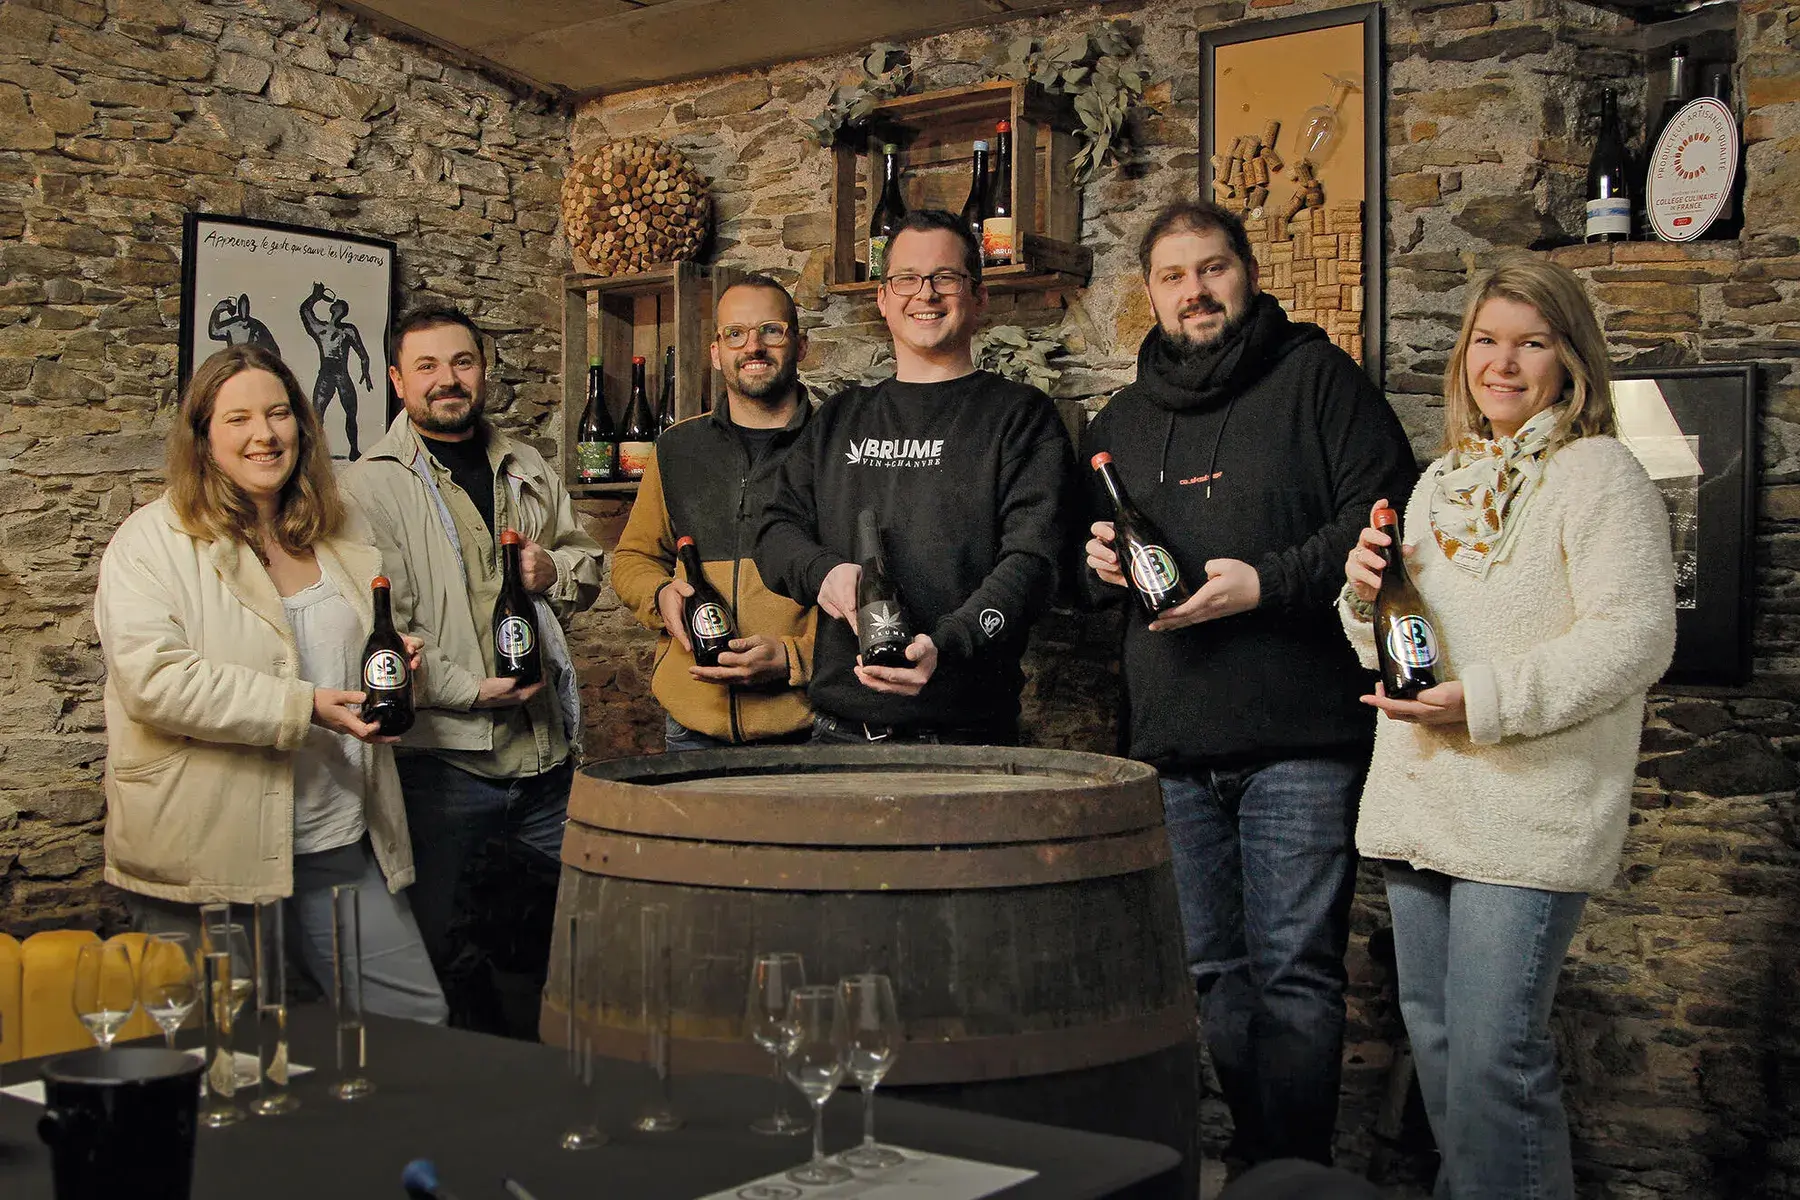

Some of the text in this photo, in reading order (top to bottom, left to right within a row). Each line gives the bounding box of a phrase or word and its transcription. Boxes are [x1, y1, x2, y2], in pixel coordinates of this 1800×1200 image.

[1657, 120, 1686, 179] PRODUCTEUR
[1687, 109, 1718, 124] ARTISAN
[1714, 121, 1724, 134] DE
[1677, 201, 1703, 211] FRANCE
[1684, 192, 1719, 203] CULINAIRE
[203, 230, 258, 253] Apprenez
[261, 235, 269, 250] le
[328, 244, 338, 259] les
[339, 244, 384, 267] Vignerons
[863, 438, 945, 460] BRUME
